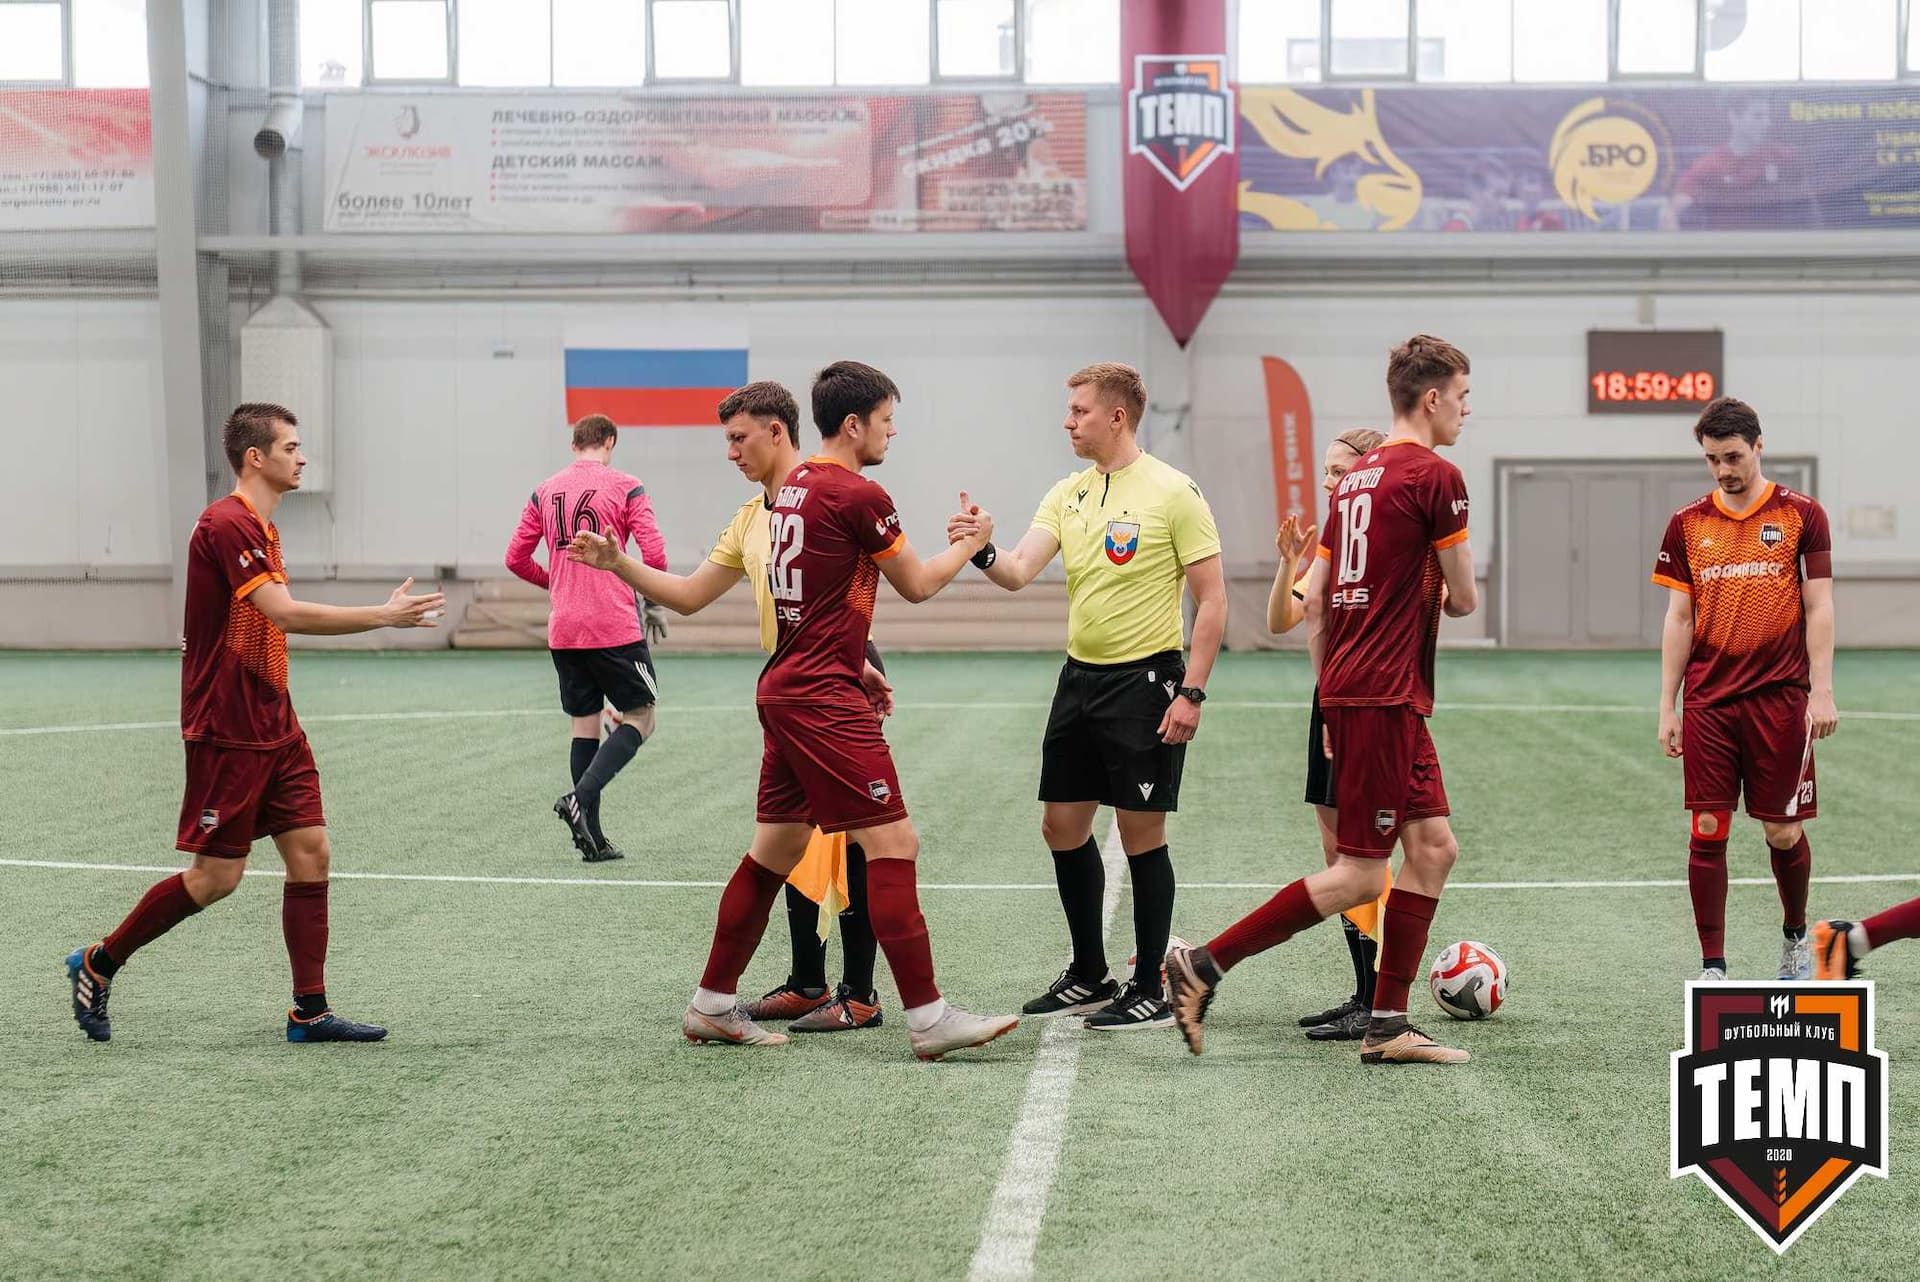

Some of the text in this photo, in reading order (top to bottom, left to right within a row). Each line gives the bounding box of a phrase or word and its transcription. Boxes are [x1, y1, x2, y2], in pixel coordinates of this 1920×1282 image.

[1139, 92, 1225, 139] ТЕМП
[492, 153, 664, 169] ДЕТСКИЙ МАССАЖ
[338, 191, 473, 210] более 10лет
[1591, 371, 1715, 401] 18:59:49
[552, 489, 601, 551] 16
[770, 512, 805, 602] 22
[1338, 493, 1372, 586] 18
[1800, 780, 1814, 805] 23
